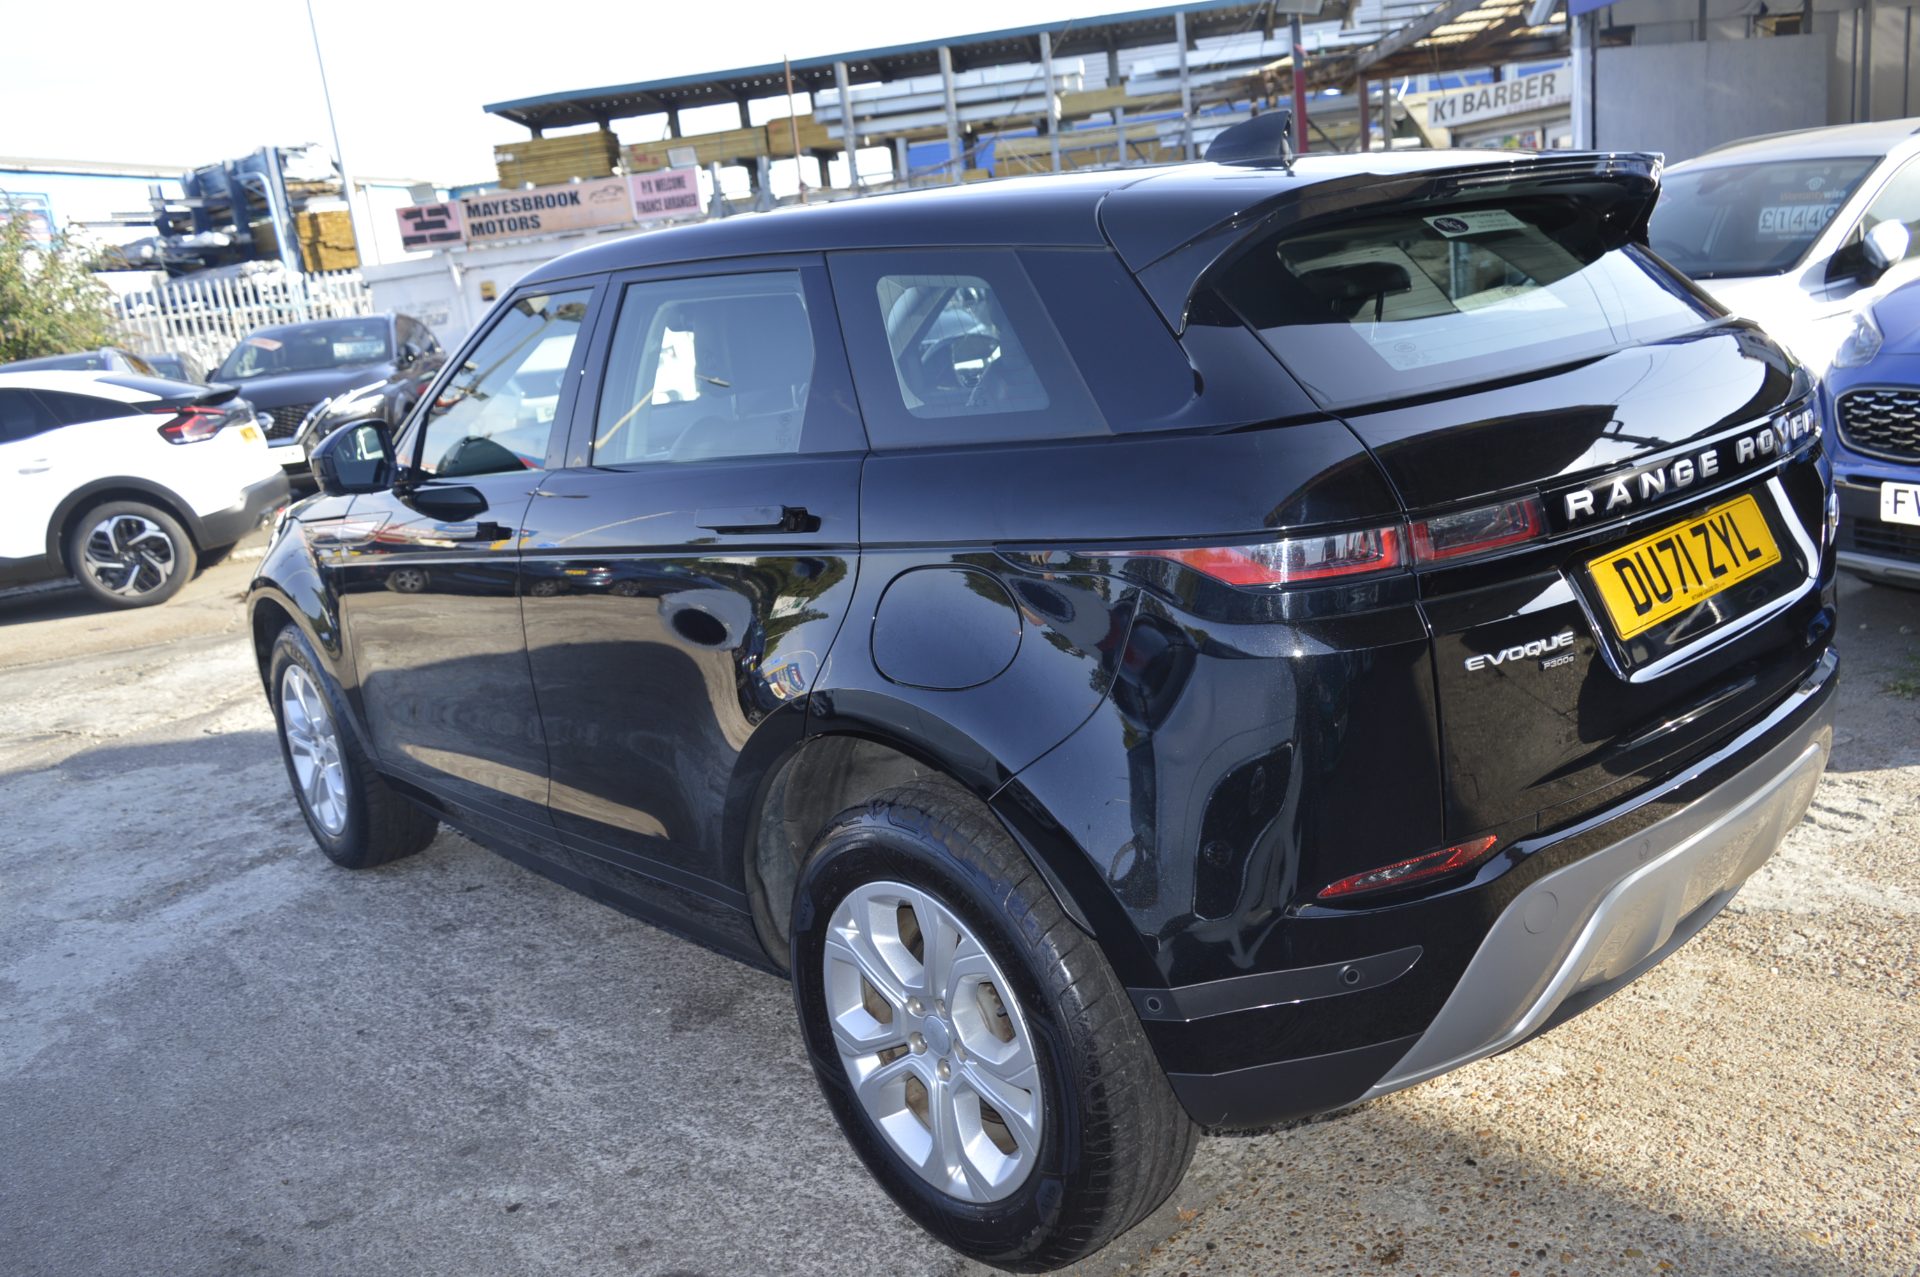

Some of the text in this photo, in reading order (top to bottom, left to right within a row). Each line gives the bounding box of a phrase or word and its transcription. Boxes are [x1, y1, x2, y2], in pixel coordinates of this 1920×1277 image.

[1433, 100, 1456, 123] K1
[1462, 73, 1556, 114] BARBER
[466, 190, 581, 219] MAYESBROOK
[470, 215, 541, 237] MOTORS
[1564, 408, 1815, 521] RANGE ROVER
[1611, 511, 1762, 617] DU71 ZYL
[1464, 631, 1574, 671] EVOQUE
